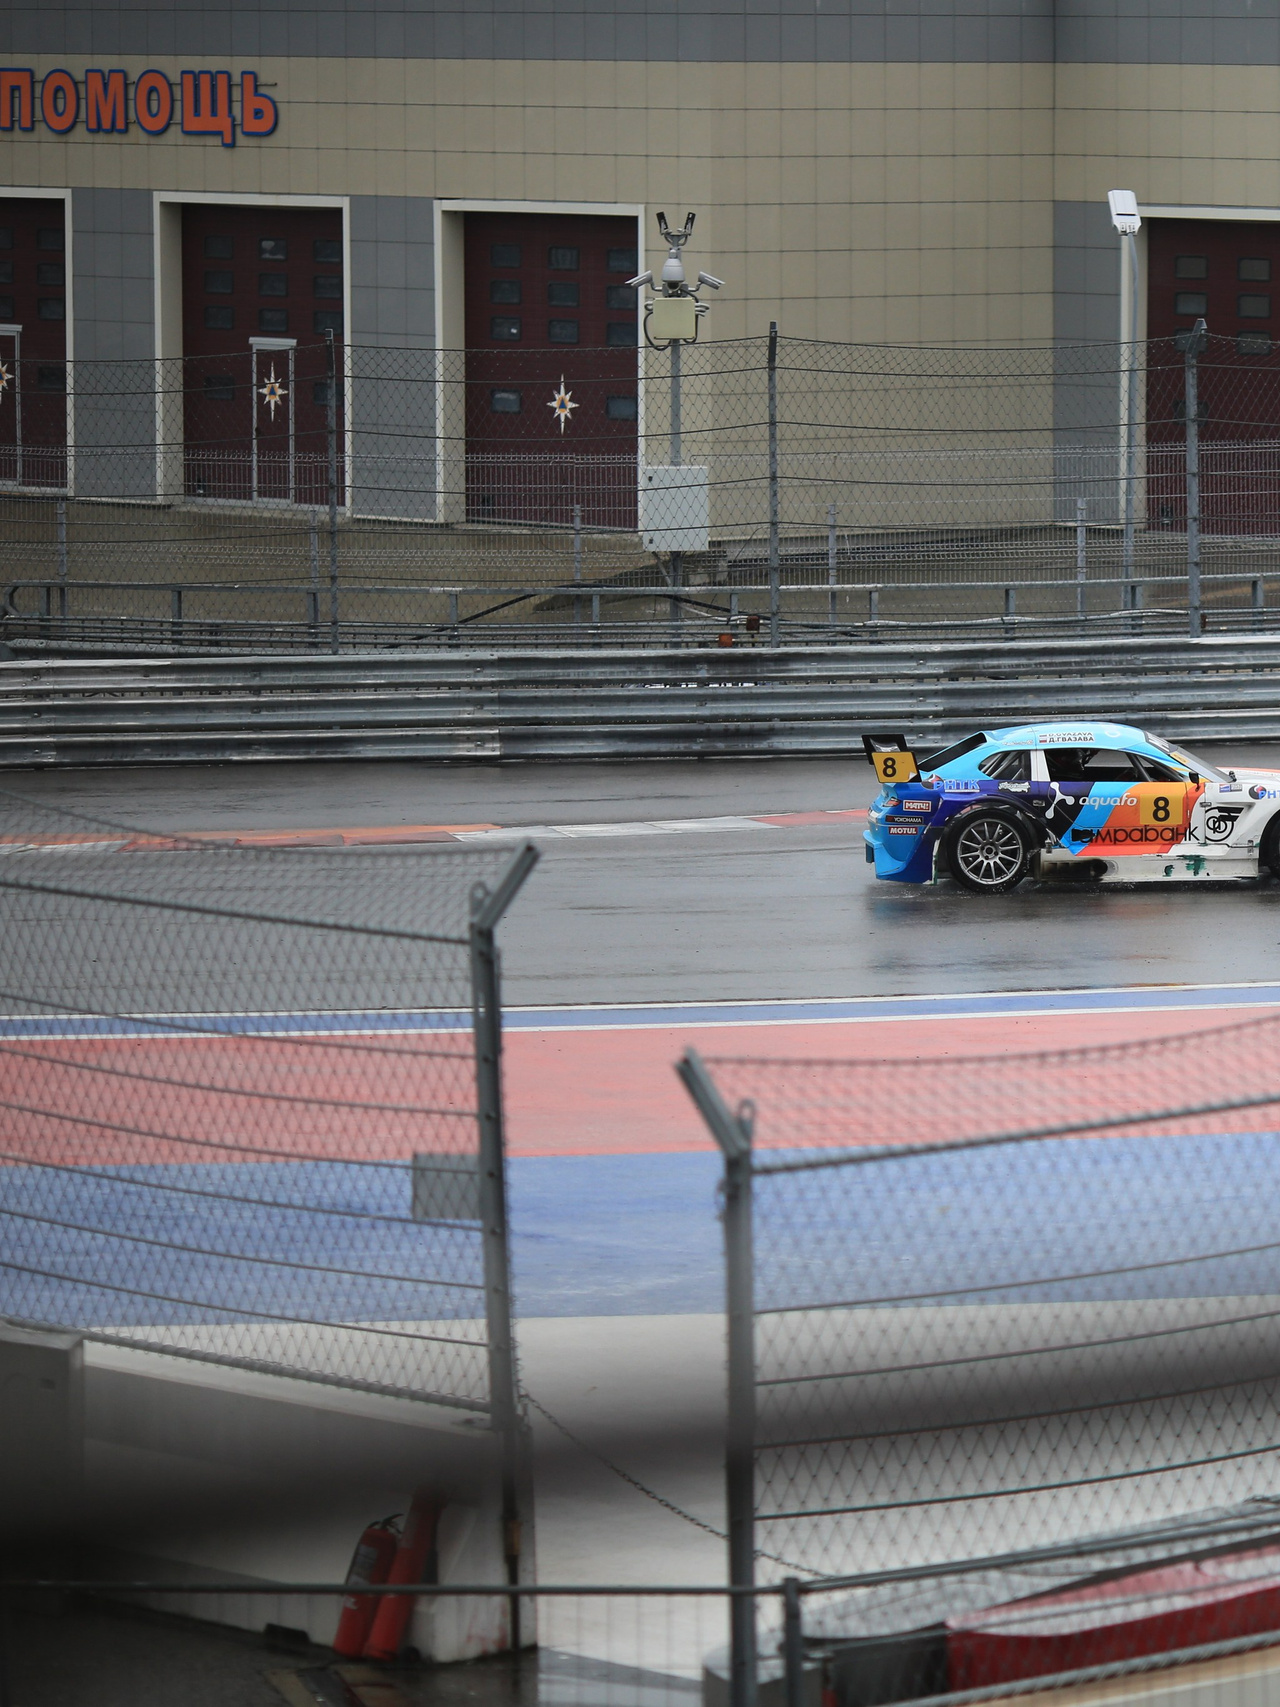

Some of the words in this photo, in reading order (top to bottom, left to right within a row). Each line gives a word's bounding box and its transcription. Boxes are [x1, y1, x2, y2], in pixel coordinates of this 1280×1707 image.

[0, 68, 278, 148] ПОМОЩЬ
[882, 757, 897, 778] 8
[1078, 792, 1138, 810] aquafo
[1152, 796, 1171, 823] 8
